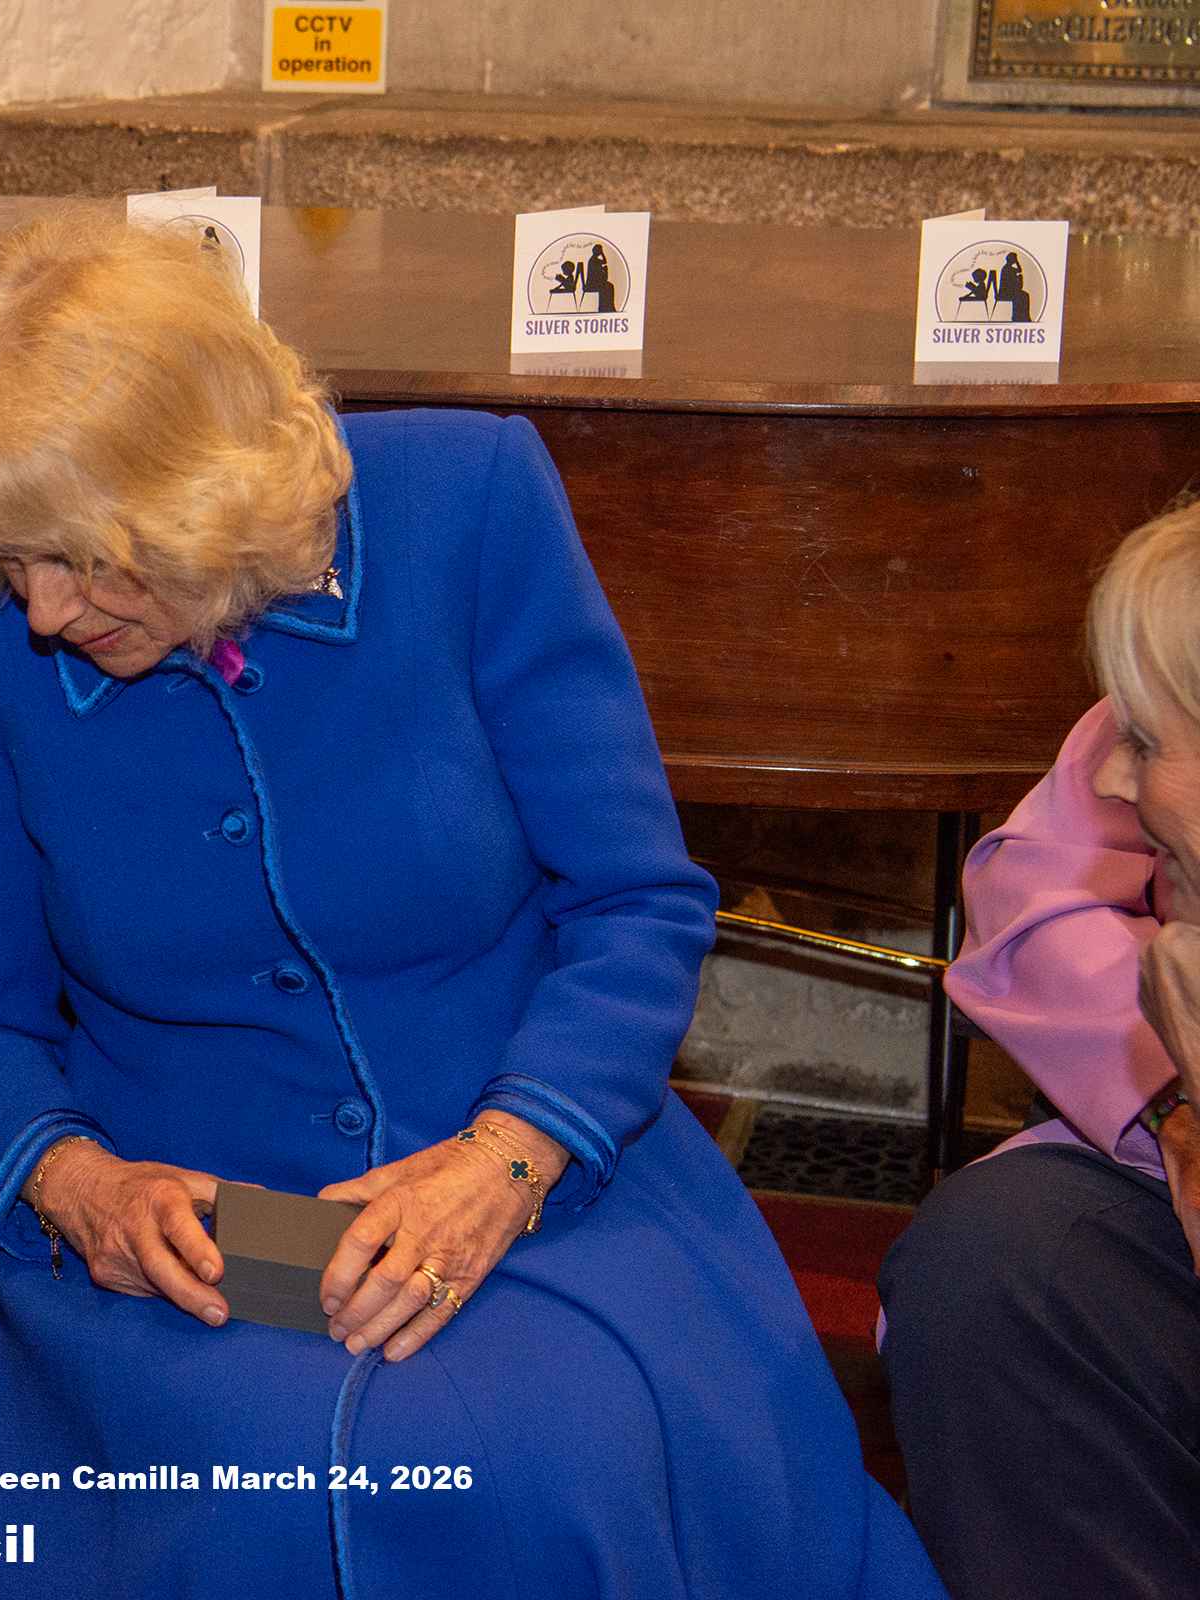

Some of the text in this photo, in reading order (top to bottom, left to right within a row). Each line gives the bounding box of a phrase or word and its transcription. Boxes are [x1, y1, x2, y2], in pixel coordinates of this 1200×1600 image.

[294, 16, 352, 32] CCTV
[314, 37, 331, 51] in
[278, 57, 372, 75] operation
[525, 318, 629, 335] SILVER STORIES
[932, 328, 1045, 344] SILVER STORIES
